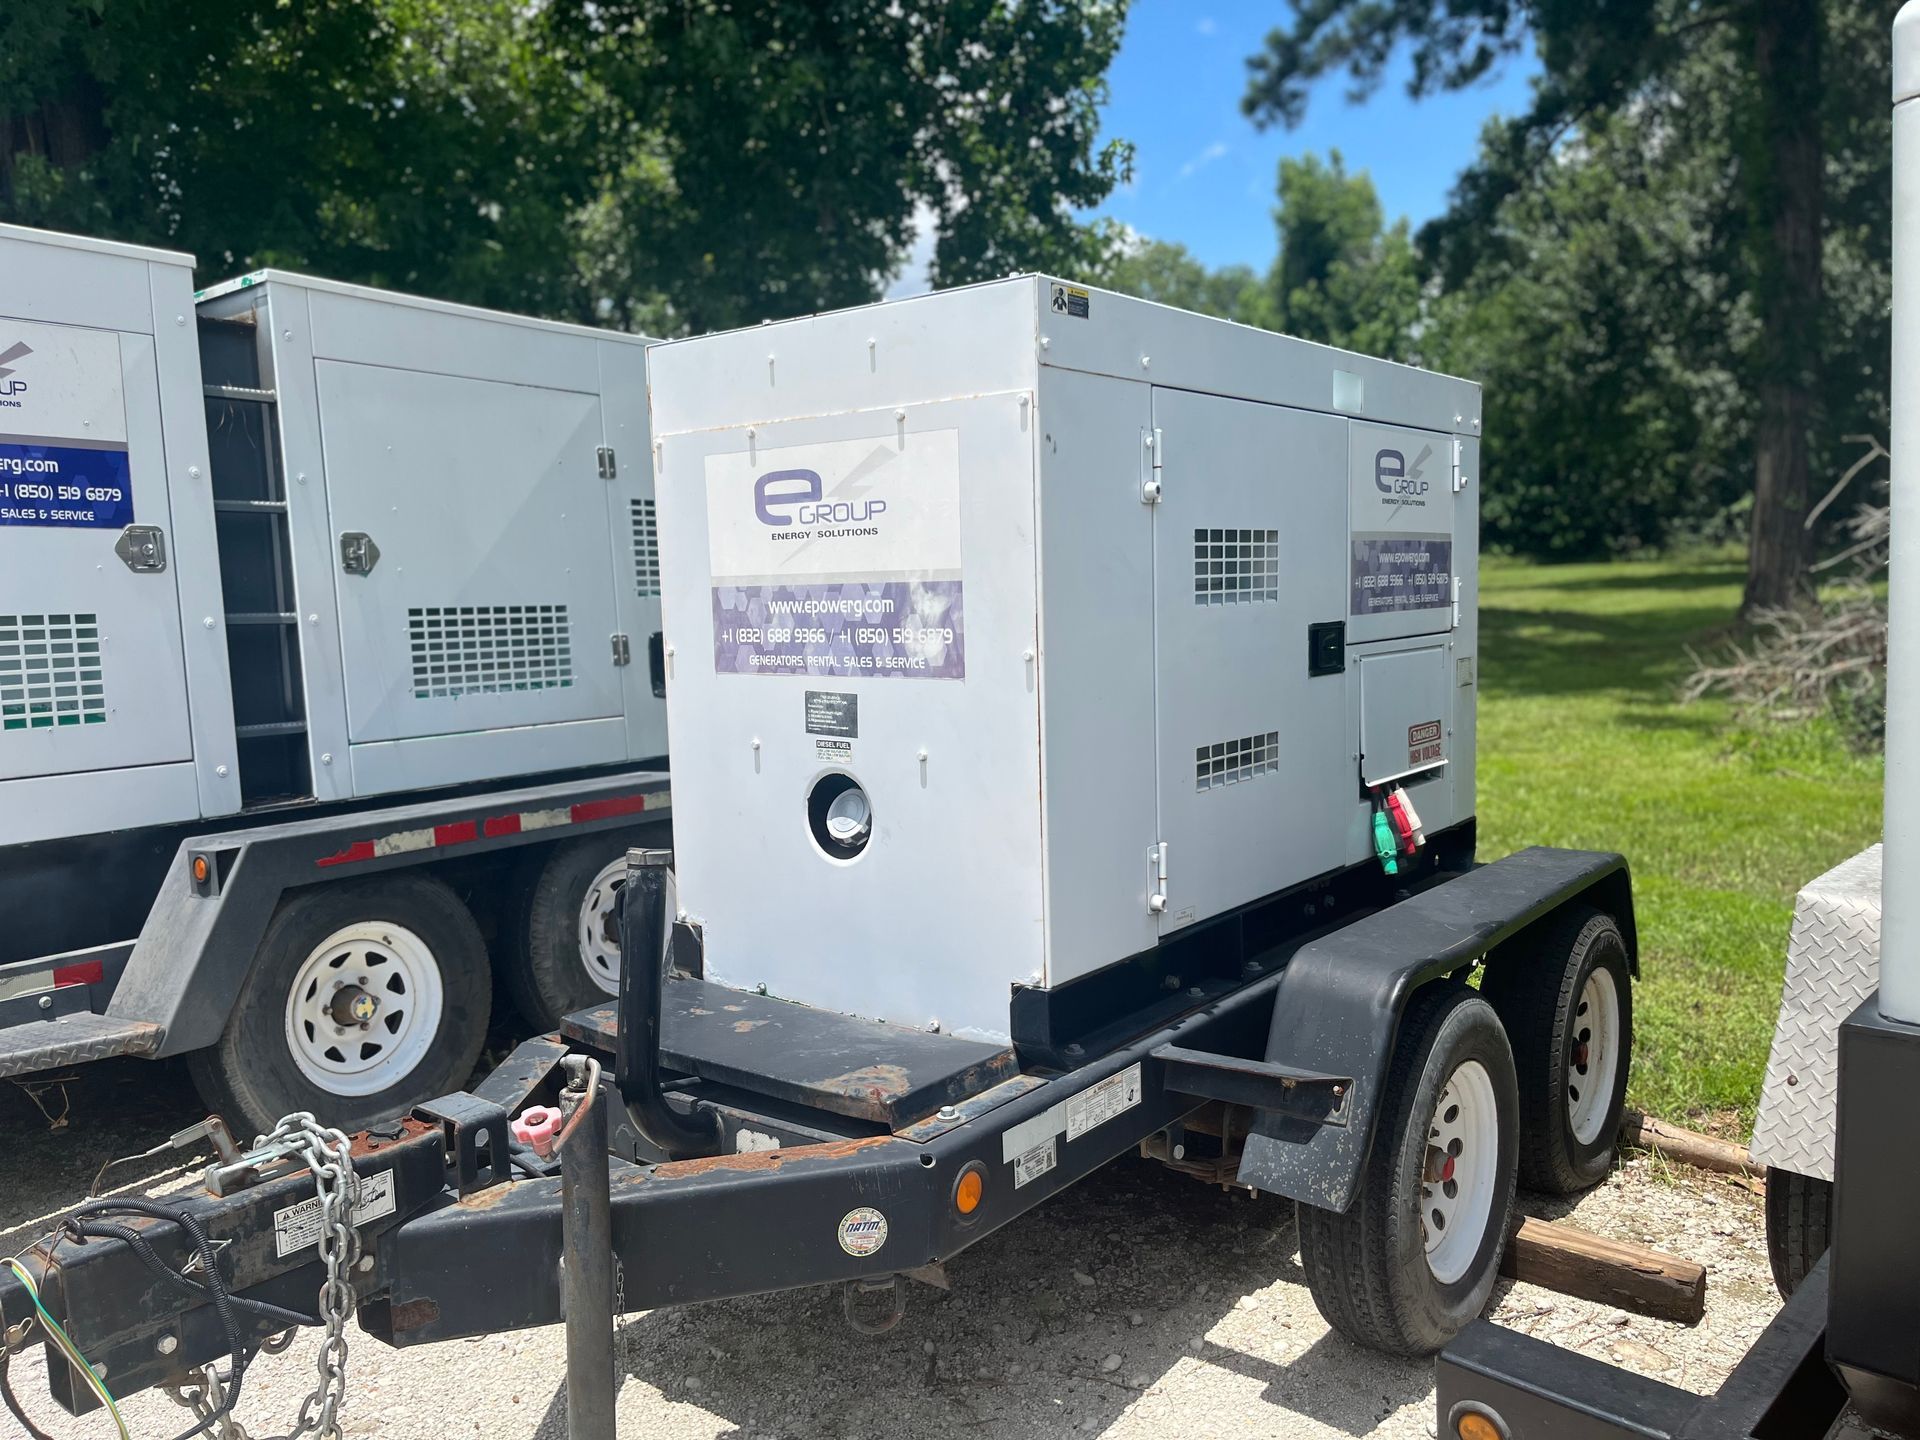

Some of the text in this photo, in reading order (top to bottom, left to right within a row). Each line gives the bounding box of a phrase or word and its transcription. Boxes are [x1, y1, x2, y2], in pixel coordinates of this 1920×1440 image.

[14, 484, 54, 501] (850)
[58, 486, 81, 500] 519
[85, 487, 122, 502] 6879
[1394, 479, 1429, 496] GROUP
[1401, 499, 1426, 507] SOLUTIONS
[1, 508, 95, 521] SALES & SERVICE
[799, 500, 887, 525] GROUP
[771, 527, 879, 541] ENERGY SOLUTIONS
[1379, 552, 1431, 566] www.epowerg.com
[768, 599, 895, 618] www.epowerg.com
[722, 628, 733, 643] +1
[736, 628, 764, 645] (832)
[767, 628, 791, 643] 688
[794, 628, 826, 643] 9366
[839, 628, 851, 644] +1
[855, 628, 889, 646] (850)
[892, 628, 913, 644] 519
[918, 628, 954, 644] 6879
[843, 656, 873, 668] SALES
[875, 657, 883, 668] &
[885, 657, 926, 669] SERVICE
[1413, 726, 1437, 741] DANGER
[292, 1200, 323, 1217] WARNI
